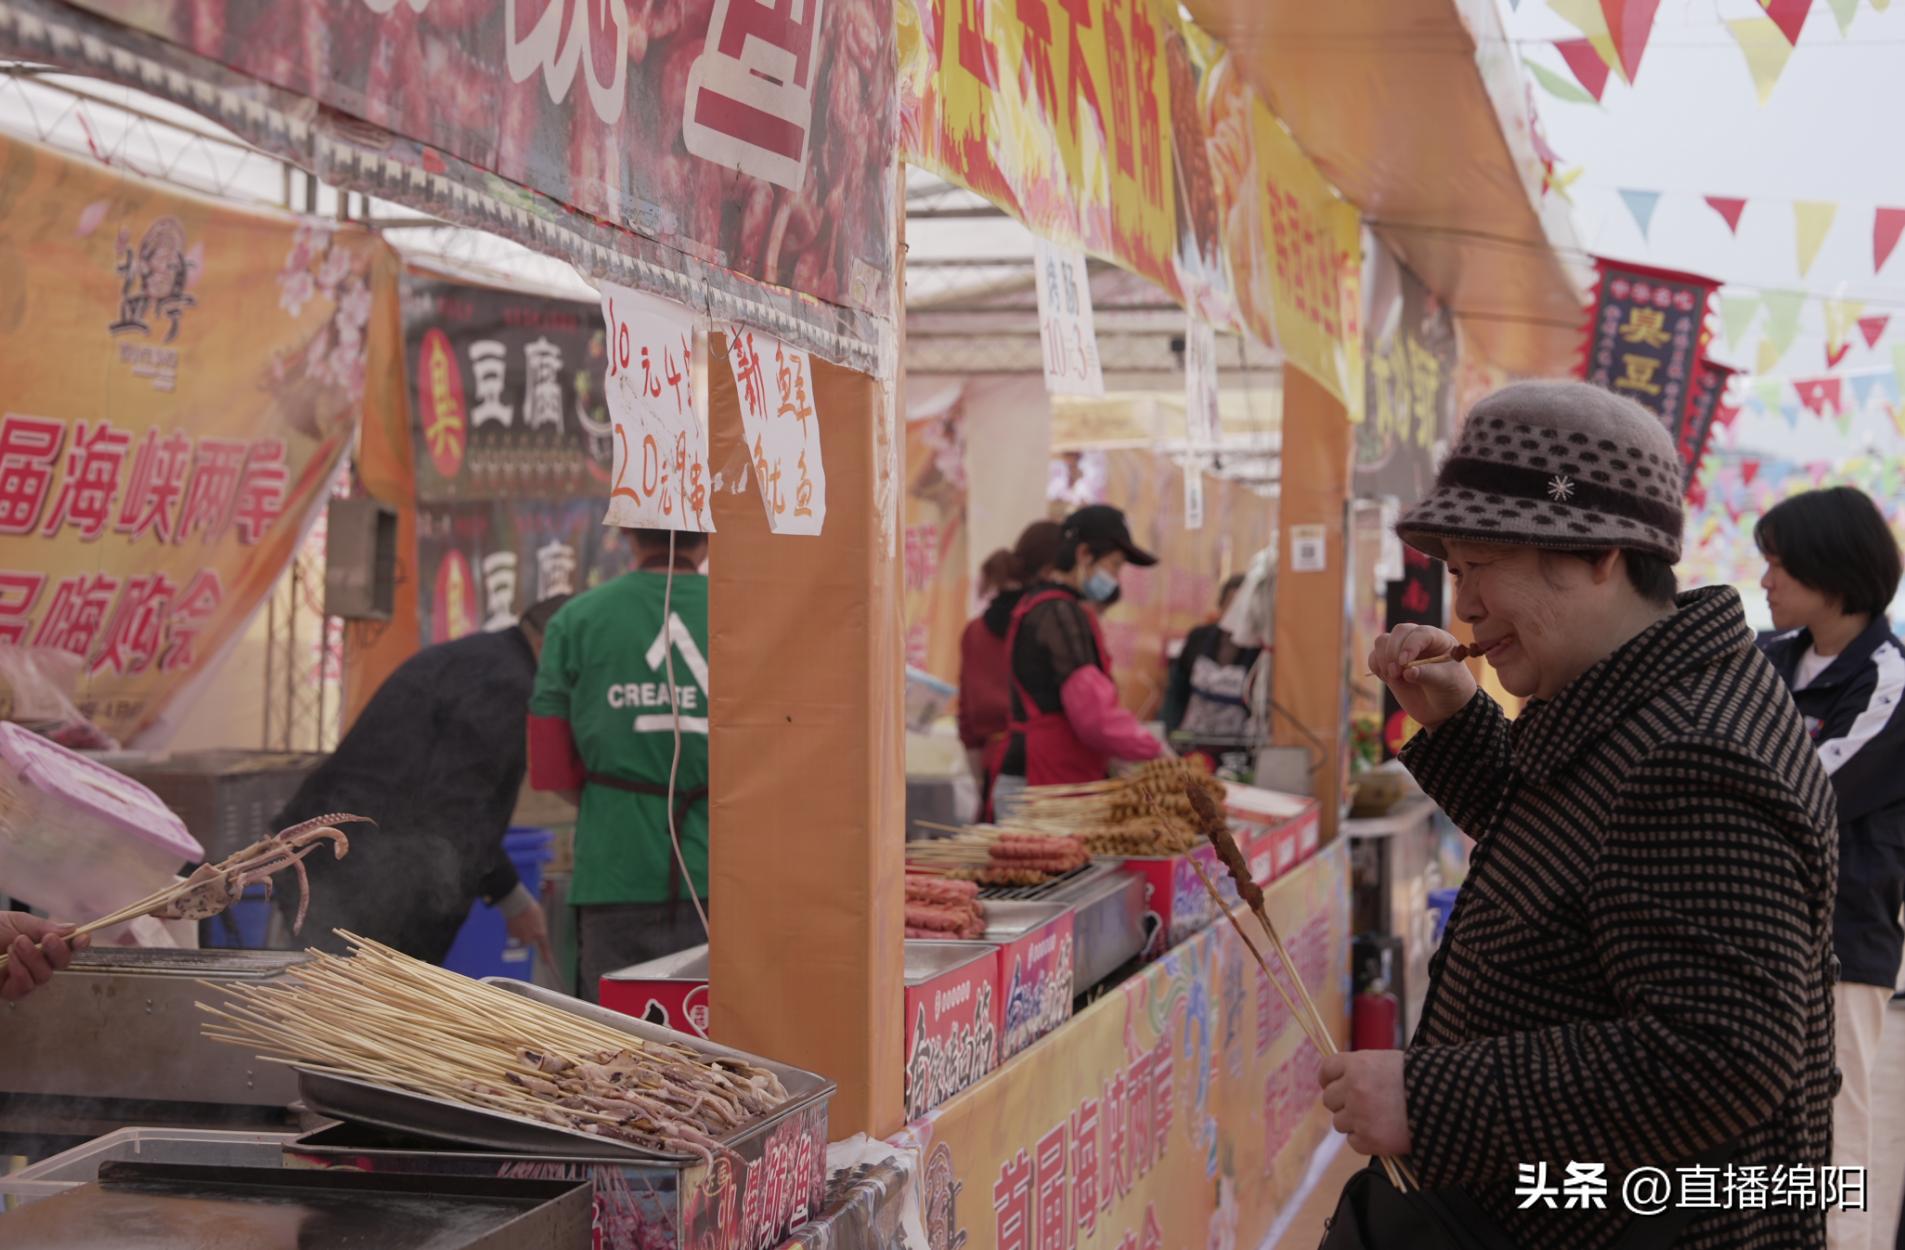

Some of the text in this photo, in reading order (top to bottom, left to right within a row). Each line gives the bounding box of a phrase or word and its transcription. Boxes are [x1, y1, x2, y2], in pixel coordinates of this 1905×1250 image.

[424, 334, 566, 462] 臭豆腐
[731, 325, 813, 440] 新鲜
[1614, 305, 1673, 396] 臭豆
[0, 412, 291, 548] 届海峡两岸
[754, 432, 813, 517] 鱿鱼
[992, 1030, 1176, 1250] 首届海峡两岸
